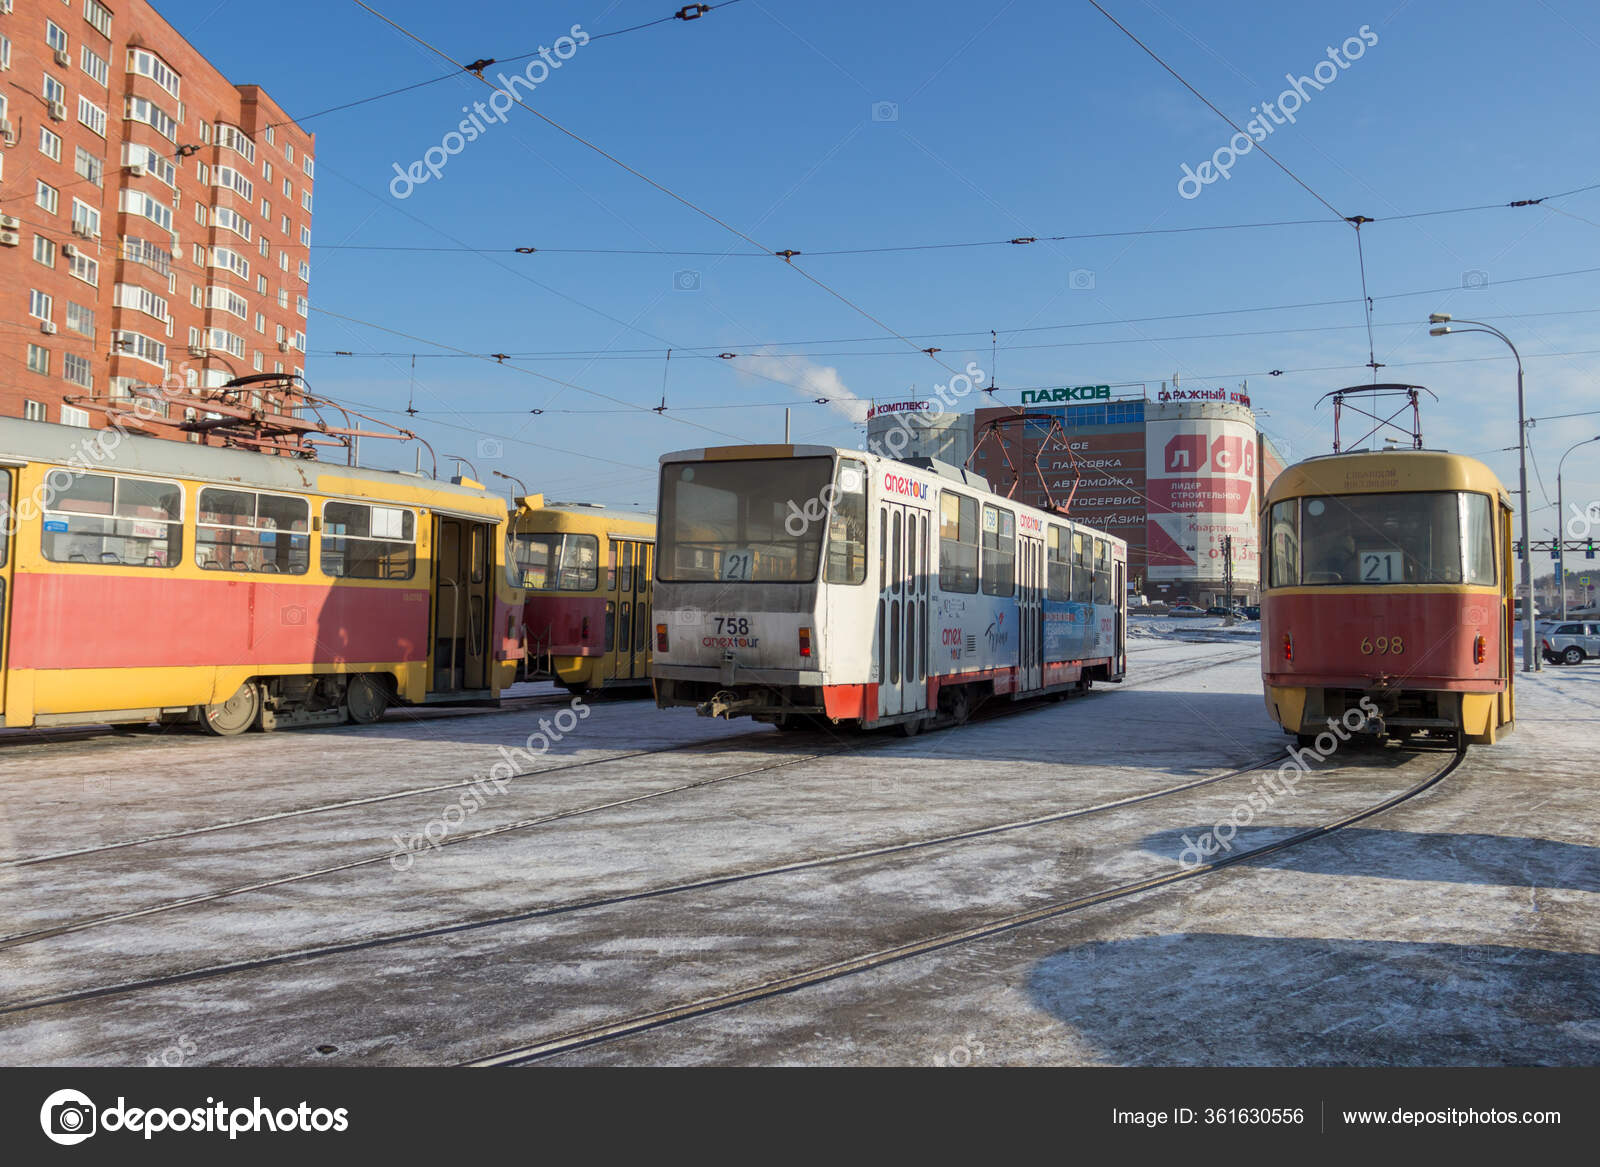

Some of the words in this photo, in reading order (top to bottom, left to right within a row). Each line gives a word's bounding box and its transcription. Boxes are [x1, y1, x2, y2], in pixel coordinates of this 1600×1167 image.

[1021, 385, 1110, 404] ПАРКОВ
[1158, 388, 1226, 401] ГАРАЖНЫЙ
[1052, 442, 1089, 451] КАФЕ
[1052, 459, 1122, 469] ПАРКОВКА
[884, 472, 929, 500] anextour
[1052, 477, 1134, 488] АВТОМОЙКА
[1170, 482, 1202, 490] ЛИДЕР
[1170, 491, 1241, 500] СТРОИТЕЛЬНОГО
[1170, 501, 1205, 509] РЫНКА
[727, 554, 748, 579] 21
[1363, 554, 1393, 582] 21
[714, 617, 749, 635] 758
[702, 637, 760, 649] anextour
[1360, 636, 1405, 655] 698
